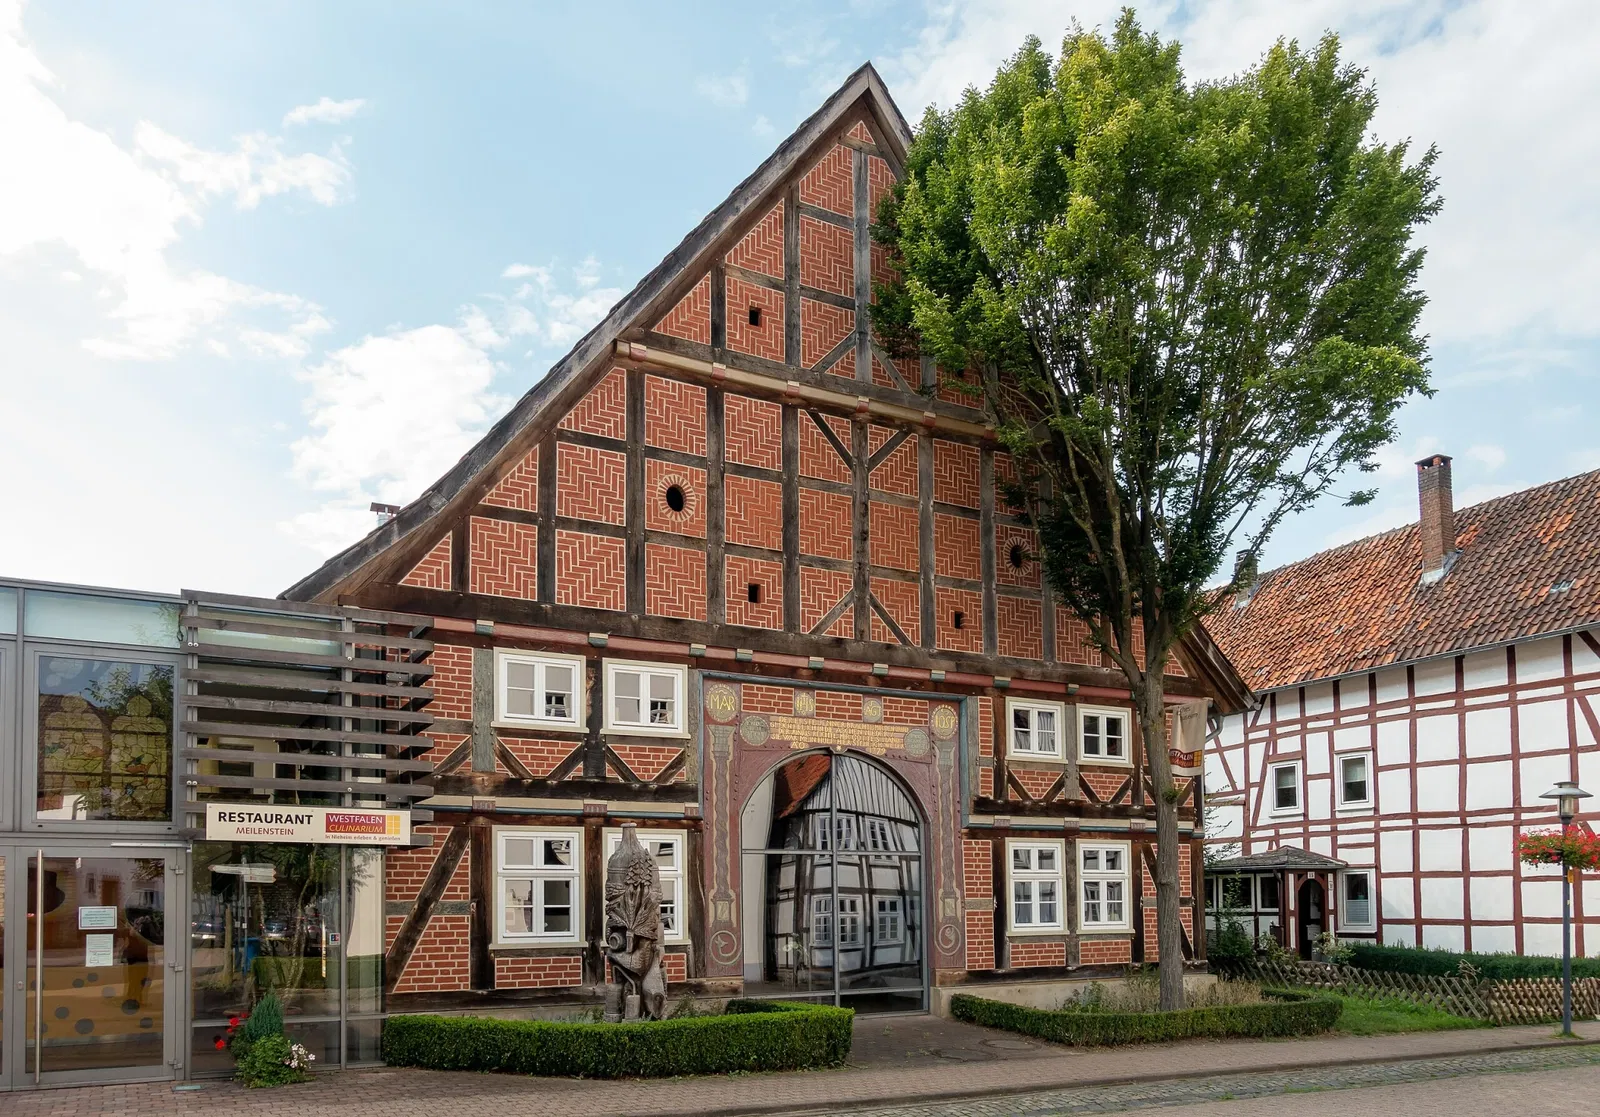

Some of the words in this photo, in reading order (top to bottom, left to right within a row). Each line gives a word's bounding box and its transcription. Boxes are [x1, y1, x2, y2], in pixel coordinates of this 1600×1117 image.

[710, 694, 735, 711] MAR
[218, 811, 313, 825] RESTAURANT
[328, 814, 383, 824] WESTFALEN
[236, 827, 294, 836] MEILENSTEIN
[328, 824, 383, 833] CULINARIUM
